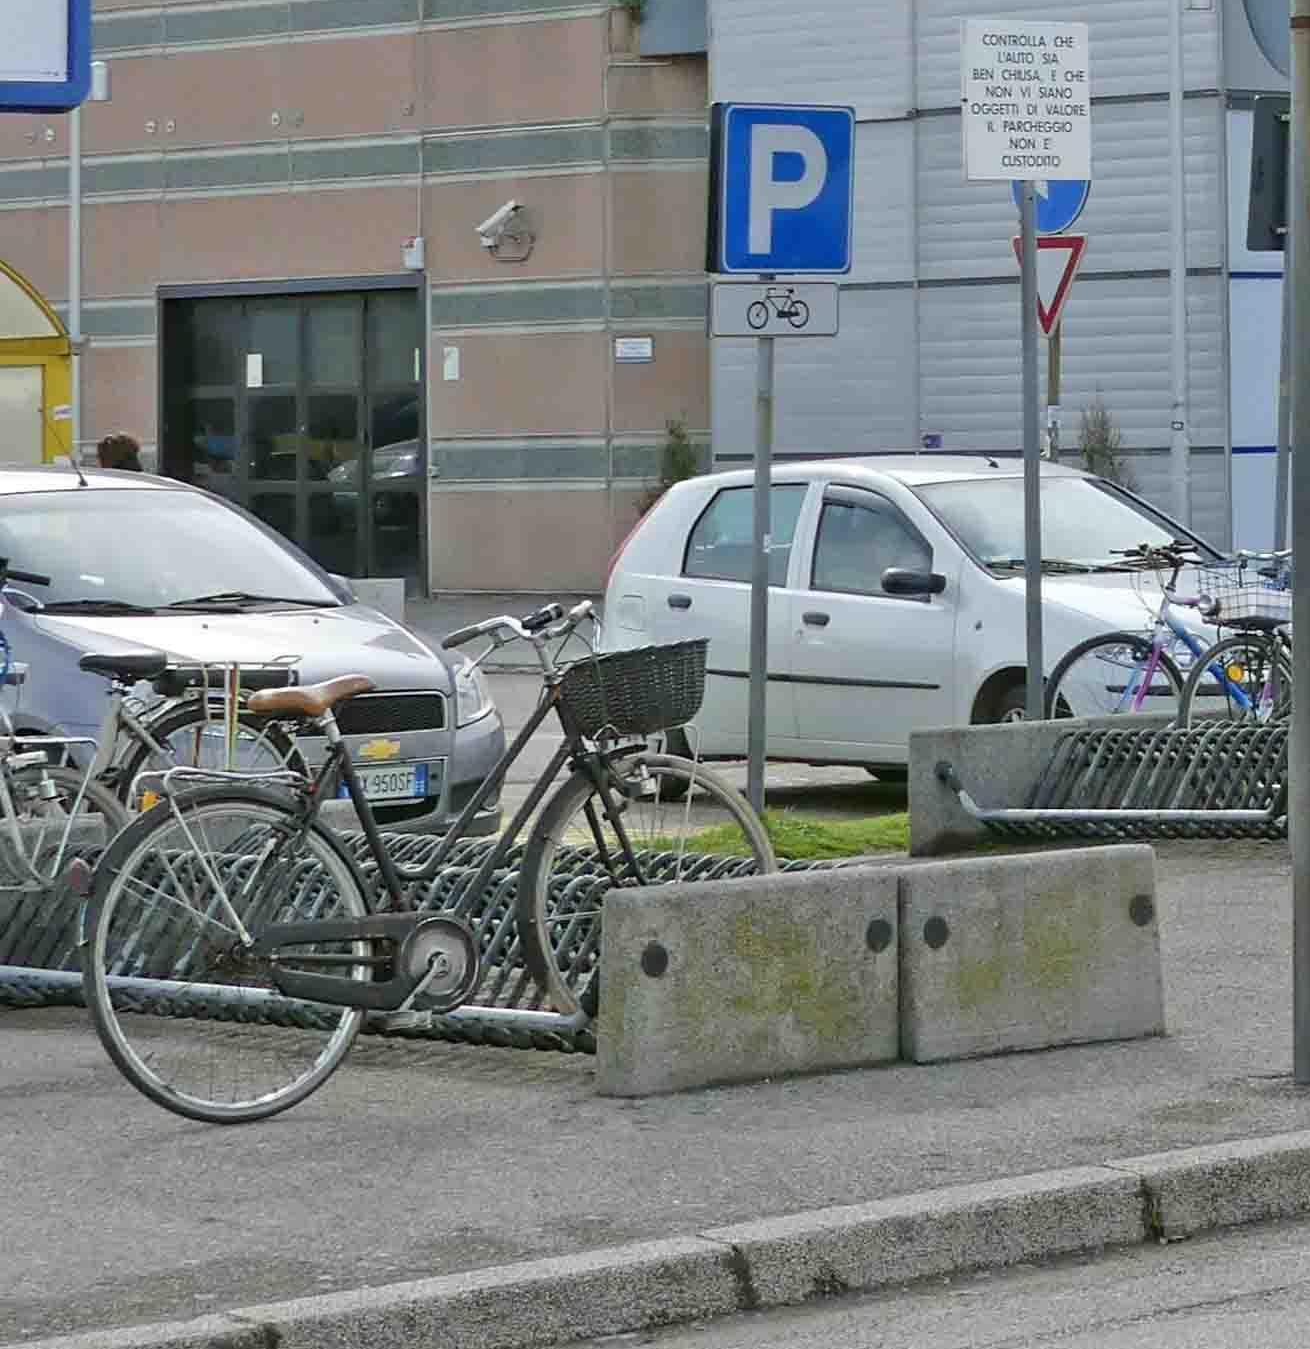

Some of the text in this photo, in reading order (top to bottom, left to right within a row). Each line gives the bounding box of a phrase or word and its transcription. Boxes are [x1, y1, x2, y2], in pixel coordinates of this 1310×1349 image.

[982, 34, 1074, 48] CONTROLLA CHE
[998, 51, 1060, 65] L'AUTO SIA
[972, 68, 994, 81] BEN
[1063, 70, 1087, 83] CHE
[985, 85, 1073, 99] NON VI SIANO
[971, 102, 1019, 115] OGGETTI
[1026, 103, 1038, 116] DI
[987, 120, 1073, 133] IL PARCHEGGIO
[1009, 137, 1036, 150] NON
[1001, 154, 1061, 167] CUSTODITO
[747, 123, 828, 255] P
